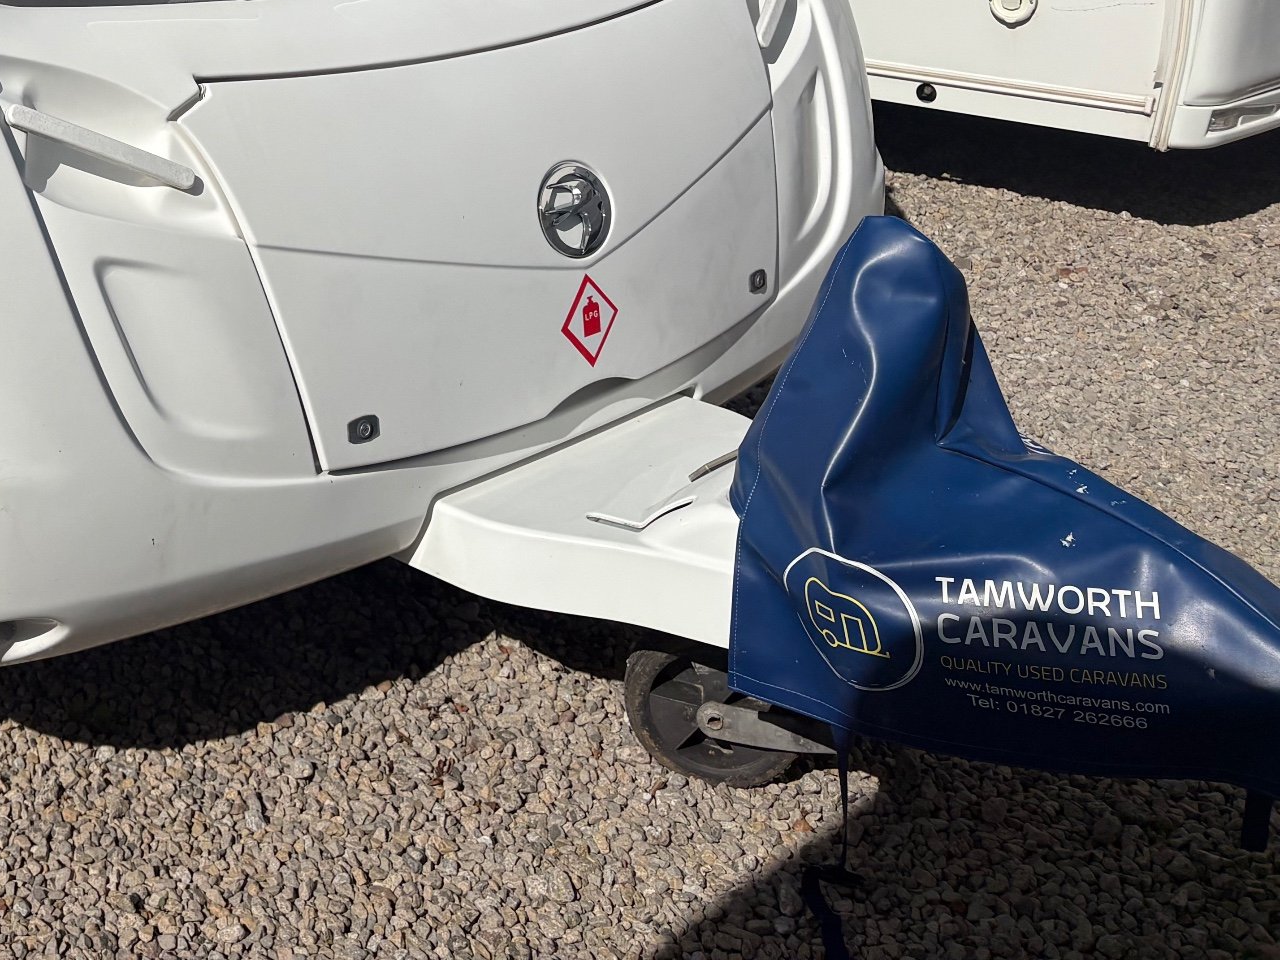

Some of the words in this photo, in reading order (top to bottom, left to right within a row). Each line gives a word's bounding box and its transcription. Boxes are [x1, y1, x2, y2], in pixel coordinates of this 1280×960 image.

[585, 310, 598, 320] LPG
[935, 576, 1161, 619] TAMWORTH
[937, 612, 1164, 660] CARAVANS
[940, 655, 1012, 676] QUALITY
[1017, 664, 1064, 682] USED
[1070, 668, 1167, 689] CARAVANS
[945, 677, 1170, 714] www.tamworthcaravans.com
[967, 693, 1000, 711] Tel:
[1006, 700, 1066, 720] 01827
[1073, 710, 1148, 729] 262666
